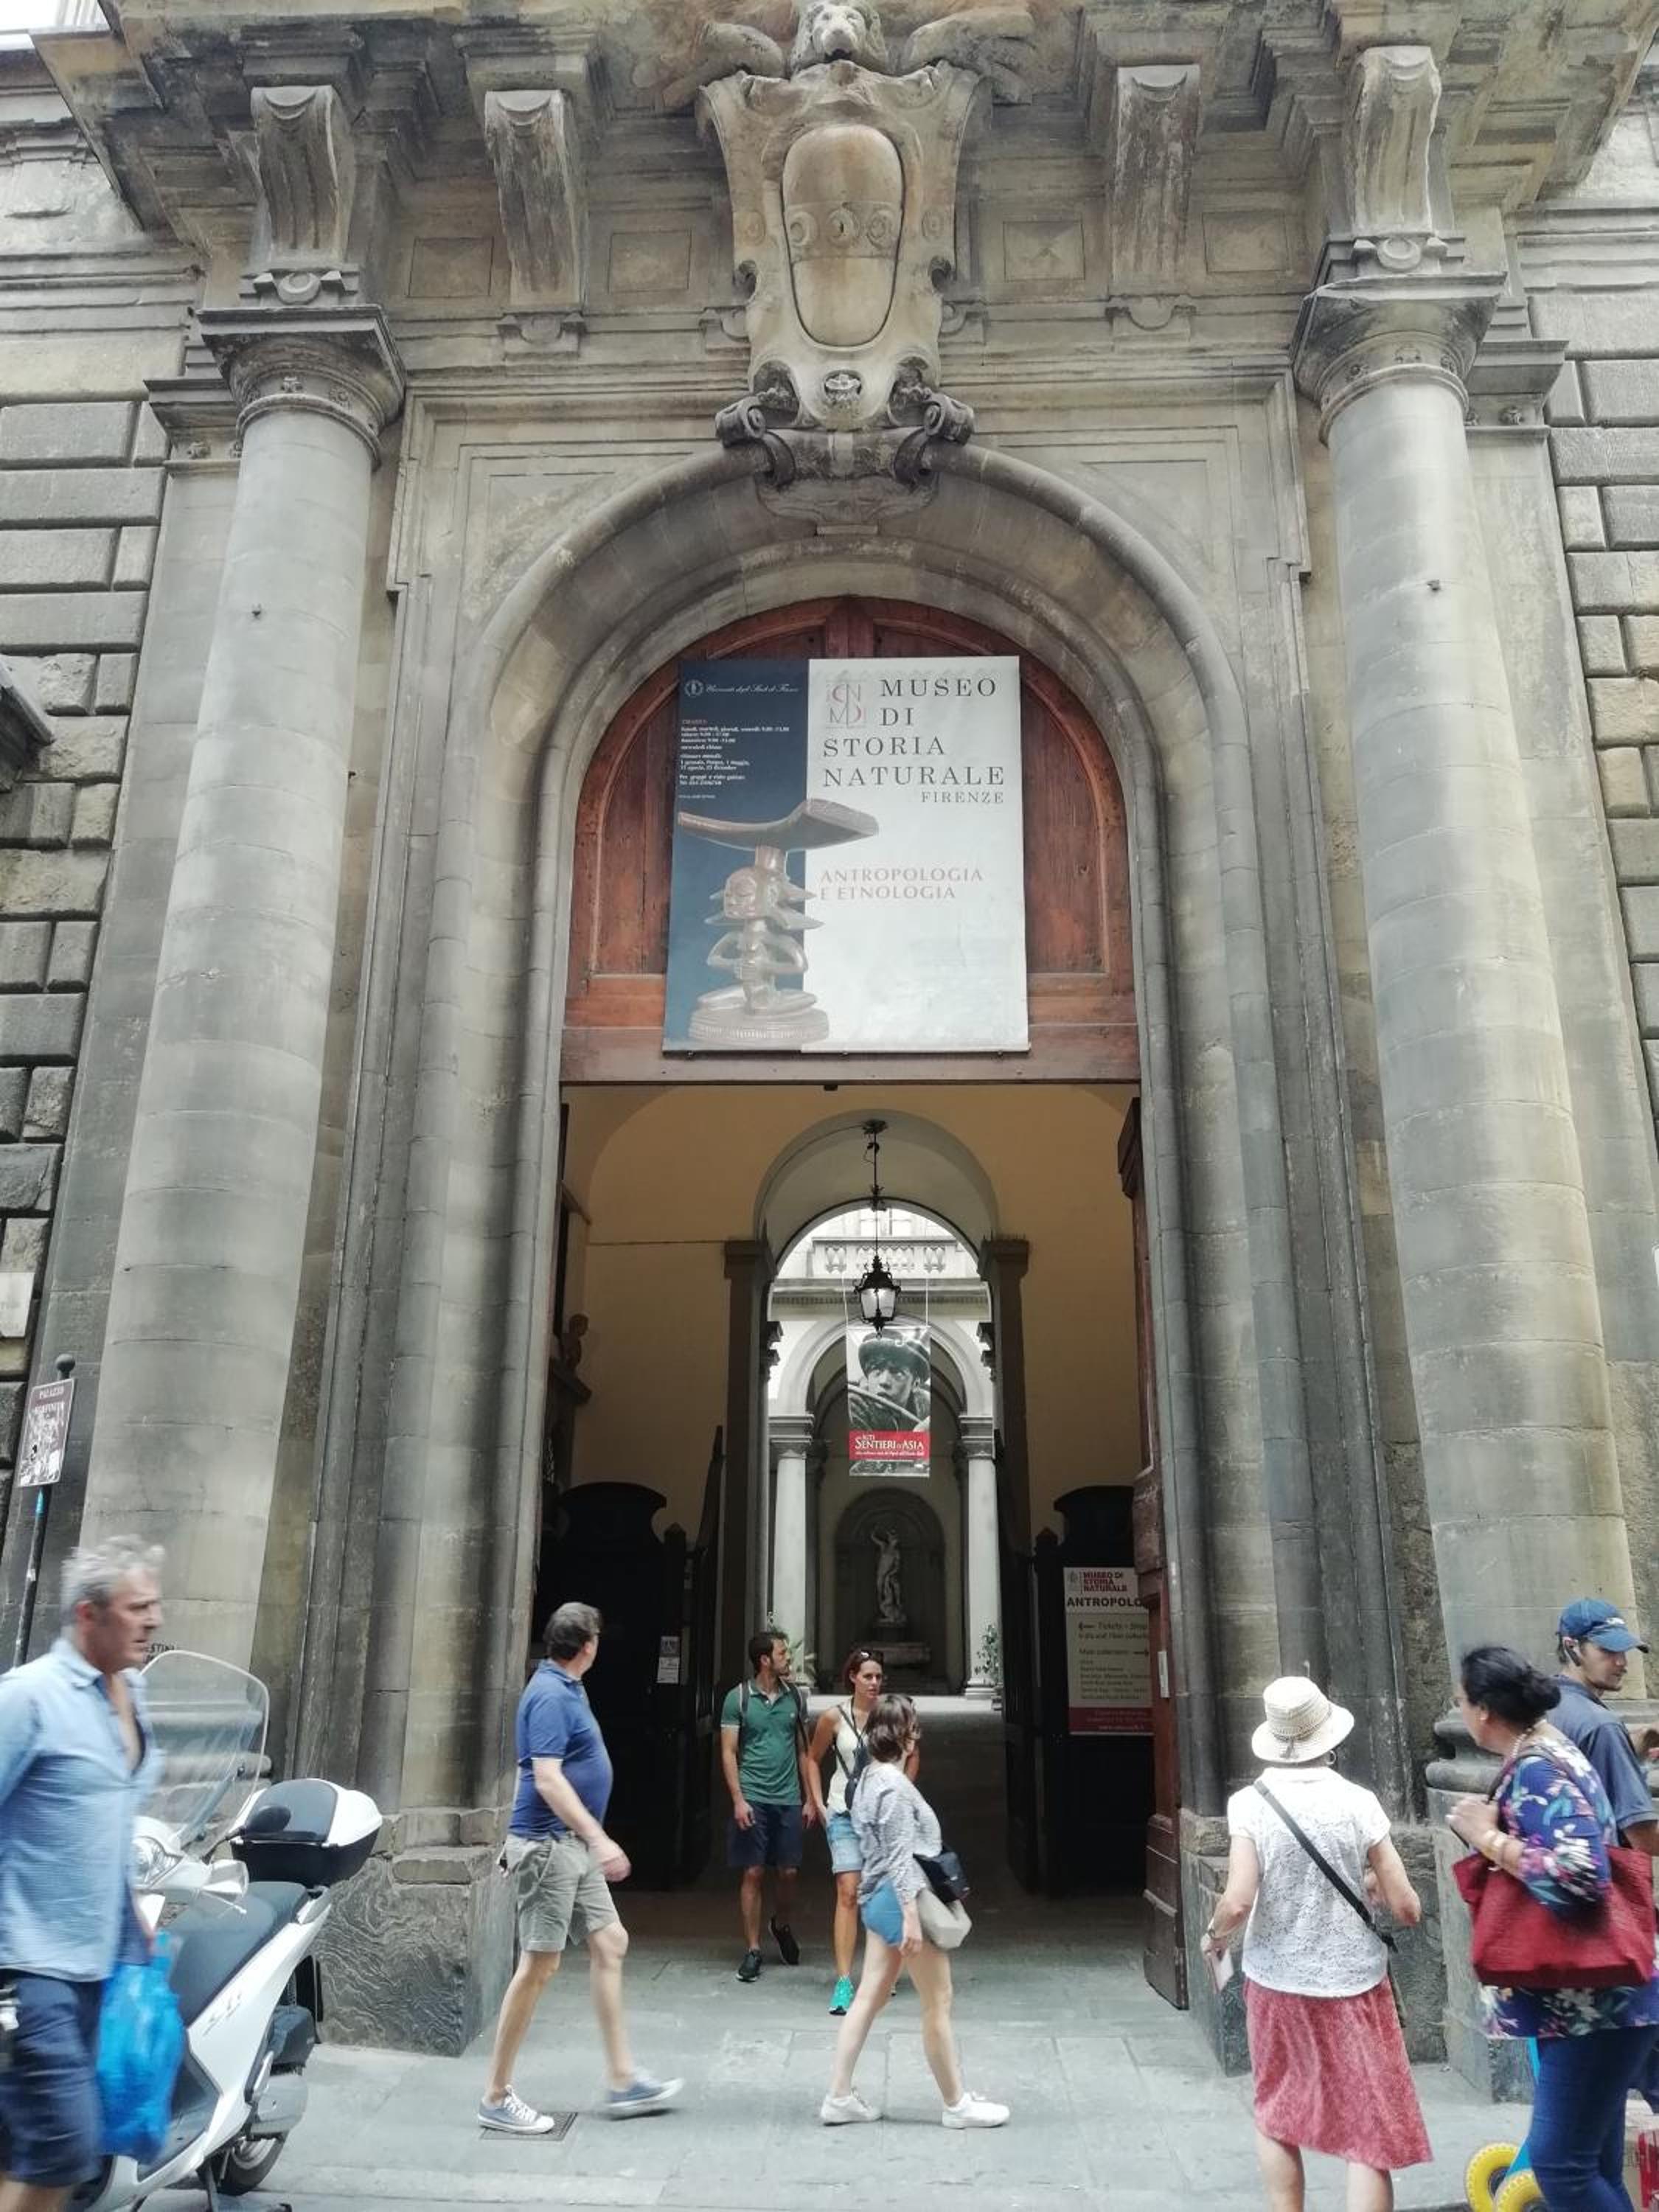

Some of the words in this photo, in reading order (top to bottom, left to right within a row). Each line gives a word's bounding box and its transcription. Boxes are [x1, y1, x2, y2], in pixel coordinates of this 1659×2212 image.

[880, 678, 996, 697] MUSEO
[880, 707, 914, 726] DI
[824, 736, 944, 757] STORIA
[823, 766, 1004, 787] NATURALE
[922, 791, 1004, 804] FIRENZE
[821, 867, 983, 883] ANTROPOLOGIA
[855, 1436, 896, 1450] SENTIERI
